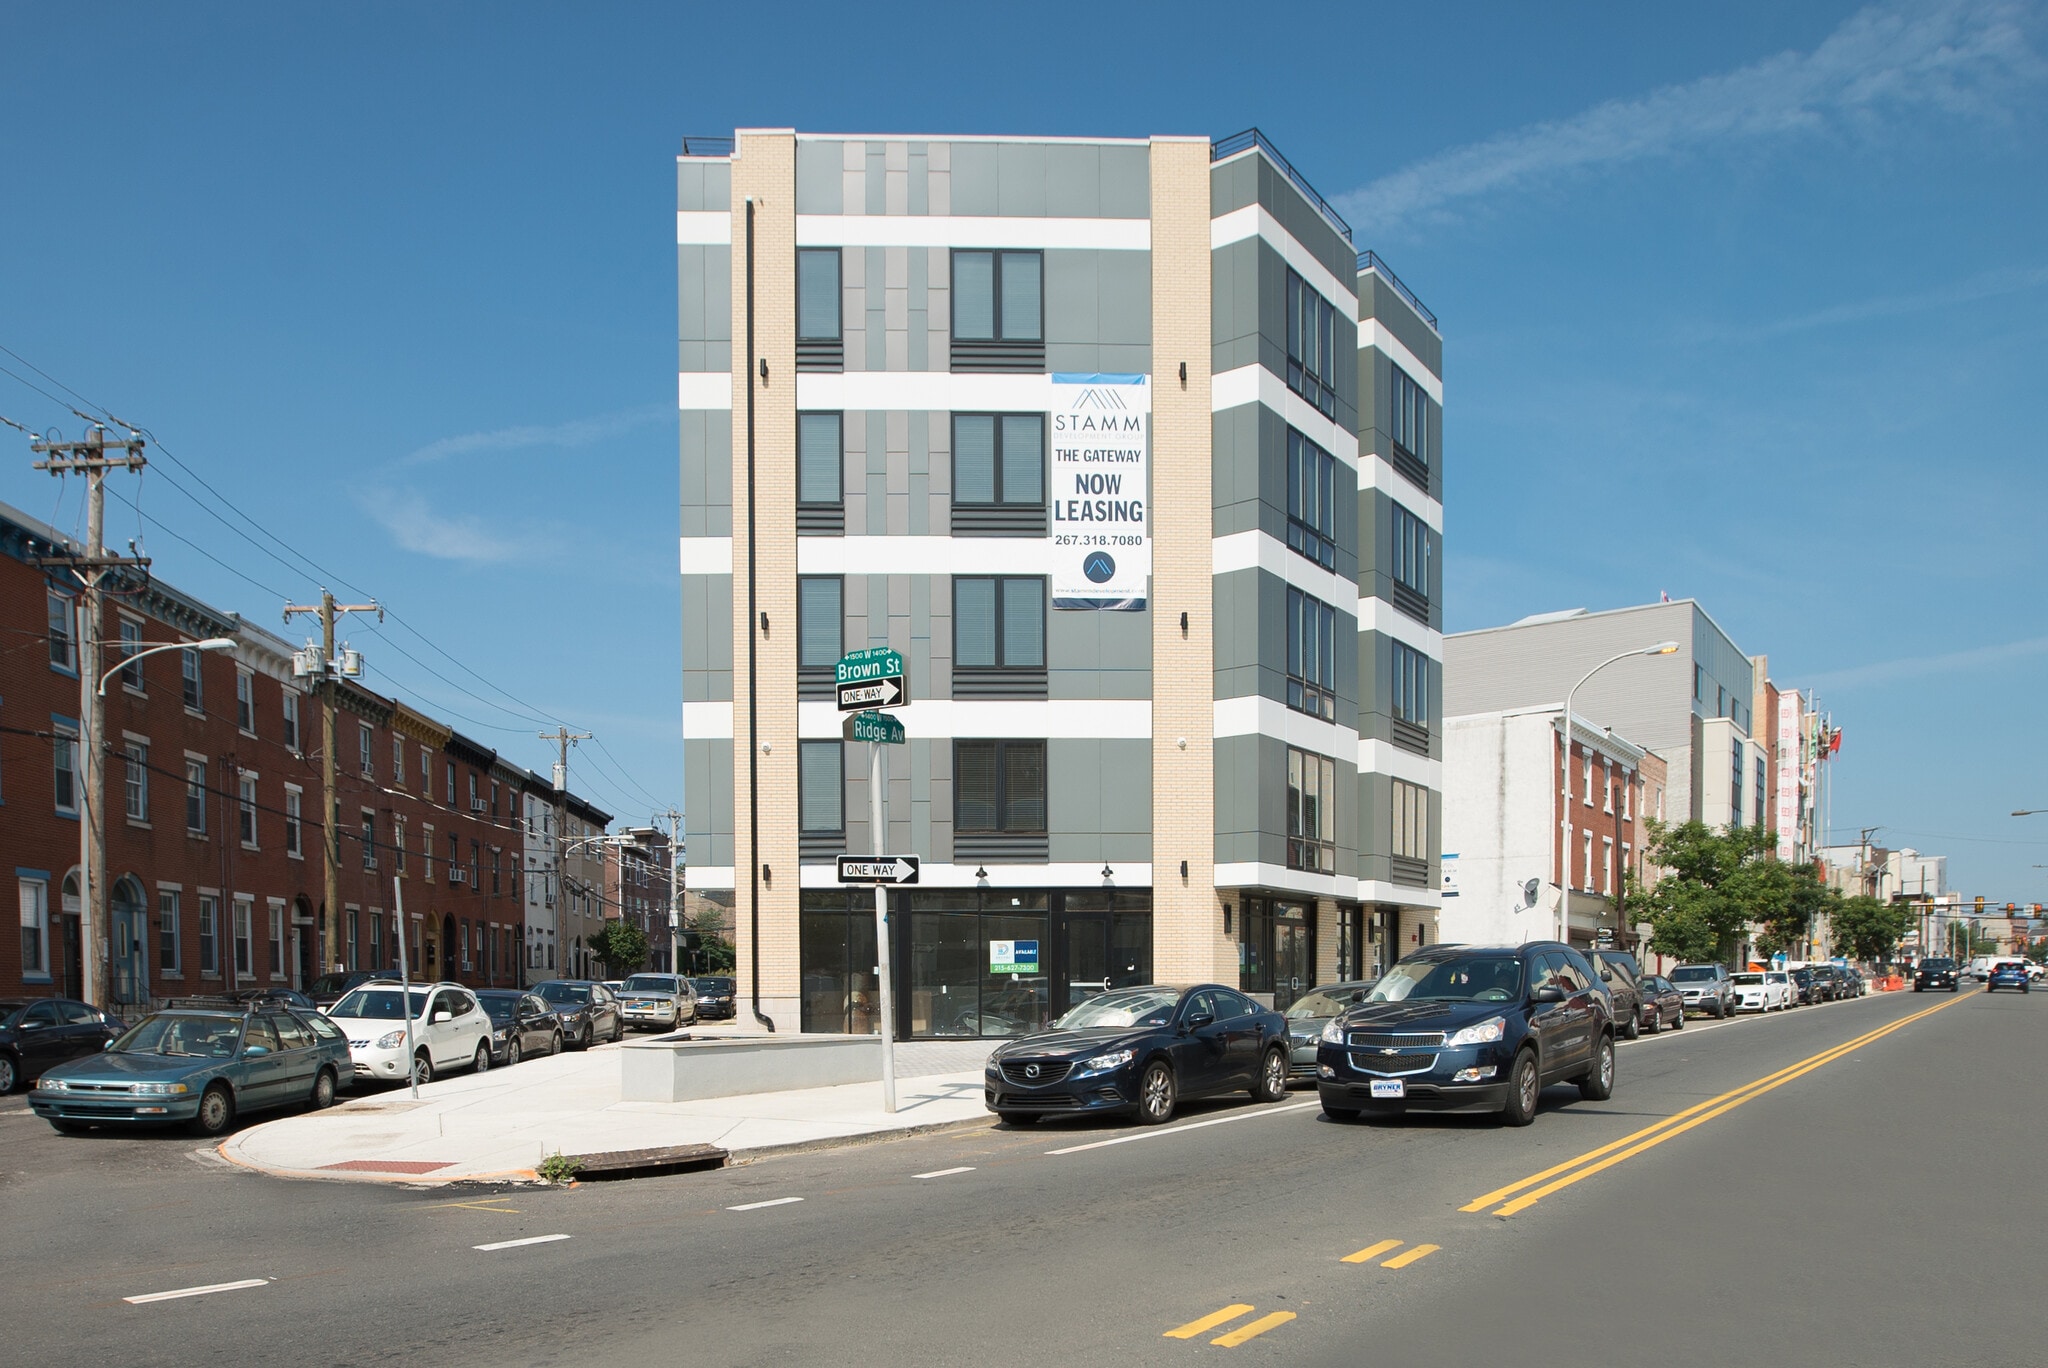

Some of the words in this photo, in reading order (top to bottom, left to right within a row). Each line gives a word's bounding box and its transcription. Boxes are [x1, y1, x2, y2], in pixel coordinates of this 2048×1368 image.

[1055, 414, 1140, 432] STAMM
[1053, 432, 1112, 440] DEVELOPMENT
[1115, 433, 1145, 441] GROUP
[1055, 449, 1080, 462] THE
[1083, 449, 1141, 463] GATEWAY
[1075, 473, 1122, 495] NOW
[1055, 500, 1143, 522] LEASING
[1055, 534, 1143, 546] 267.318.7080
[864, 650, 872, 659] W
[838, 662, 880, 680] Brown
[886, 658, 900, 674] St
[843, 690, 861, 703] ONE
[863, 687, 882, 700] WAY
[855, 721, 887, 742] Ridge
[891, 726, 904, 741] Av
[847, 864, 869, 876] ONE
[872, 865, 896, 876] WAY
